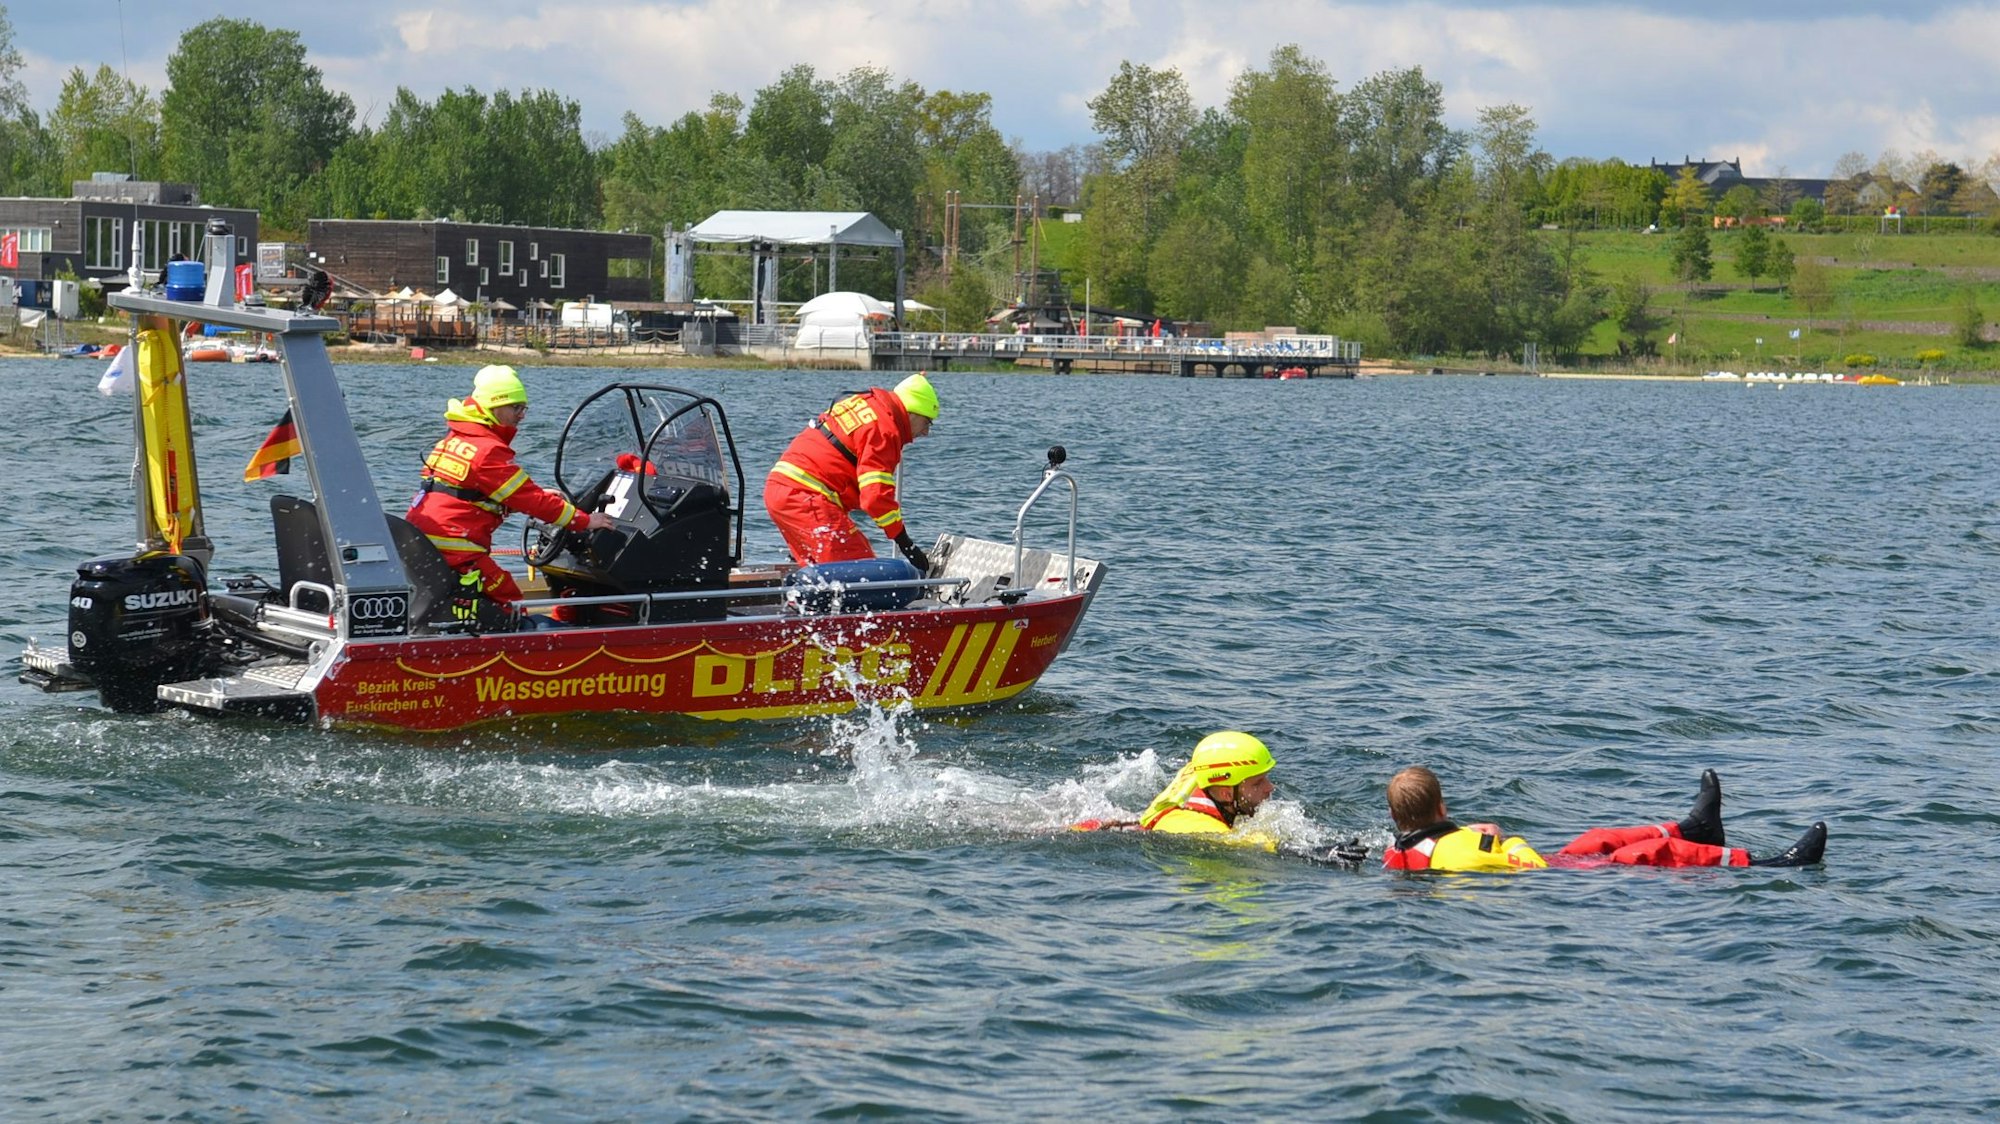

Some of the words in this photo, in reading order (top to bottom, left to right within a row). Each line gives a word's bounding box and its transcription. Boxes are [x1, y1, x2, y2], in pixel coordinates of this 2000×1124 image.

[71, 596, 93, 610] 40
[125, 589, 198, 611] SUZUKI
[1030, 632, 1058, 649] Herbert
[692, 643, 912, 697] DLRG
[358, 680, 400, 695] Bezirk
[402, 678, 436, 692] Kreis
[475, 672, 667, 703] Wasserrettung
[421, 695, 446, 709] e.V.
